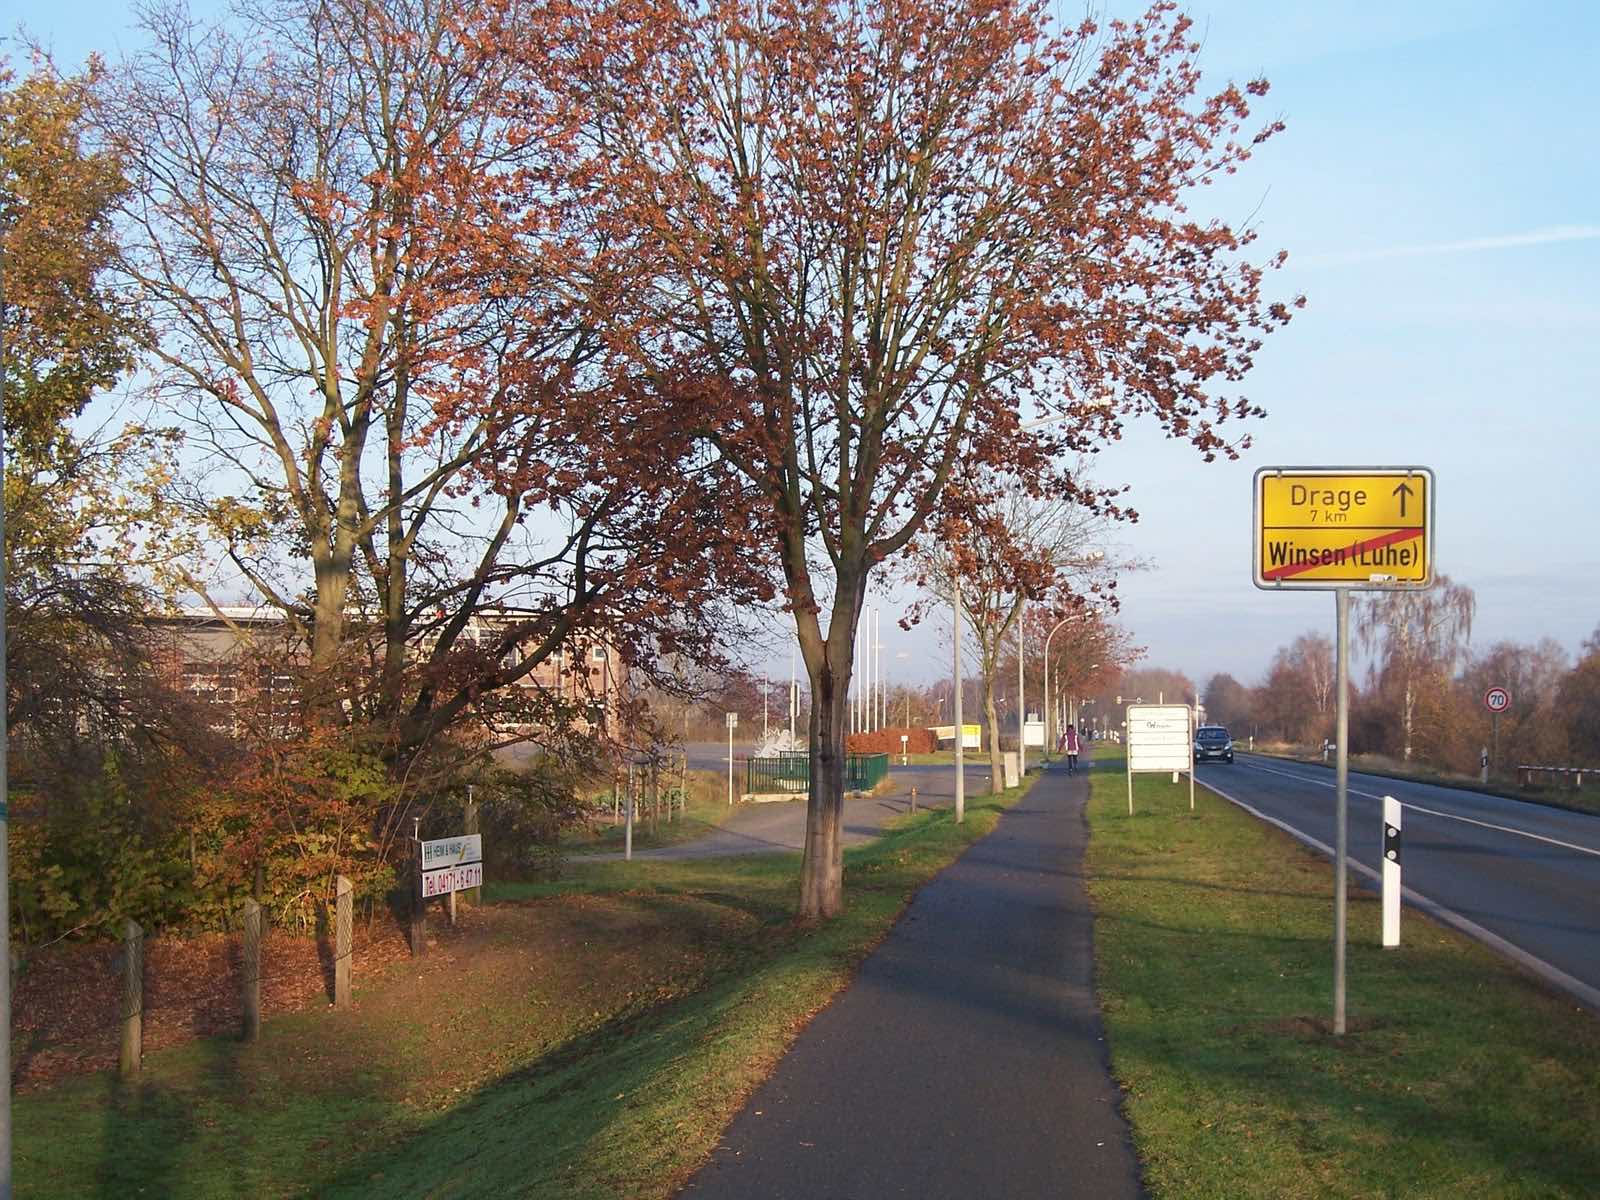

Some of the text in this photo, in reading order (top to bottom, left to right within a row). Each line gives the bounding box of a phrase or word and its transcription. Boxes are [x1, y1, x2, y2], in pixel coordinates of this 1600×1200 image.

[1291, 485, 1367, 510] Drage
[1310, 509, 1347, 522] 7 km
[1269, 540, 1418, 568] Winsen (Luhe)
[1491, 695, 1504, 705] 70
[438, 871, 456, 893] 04171
